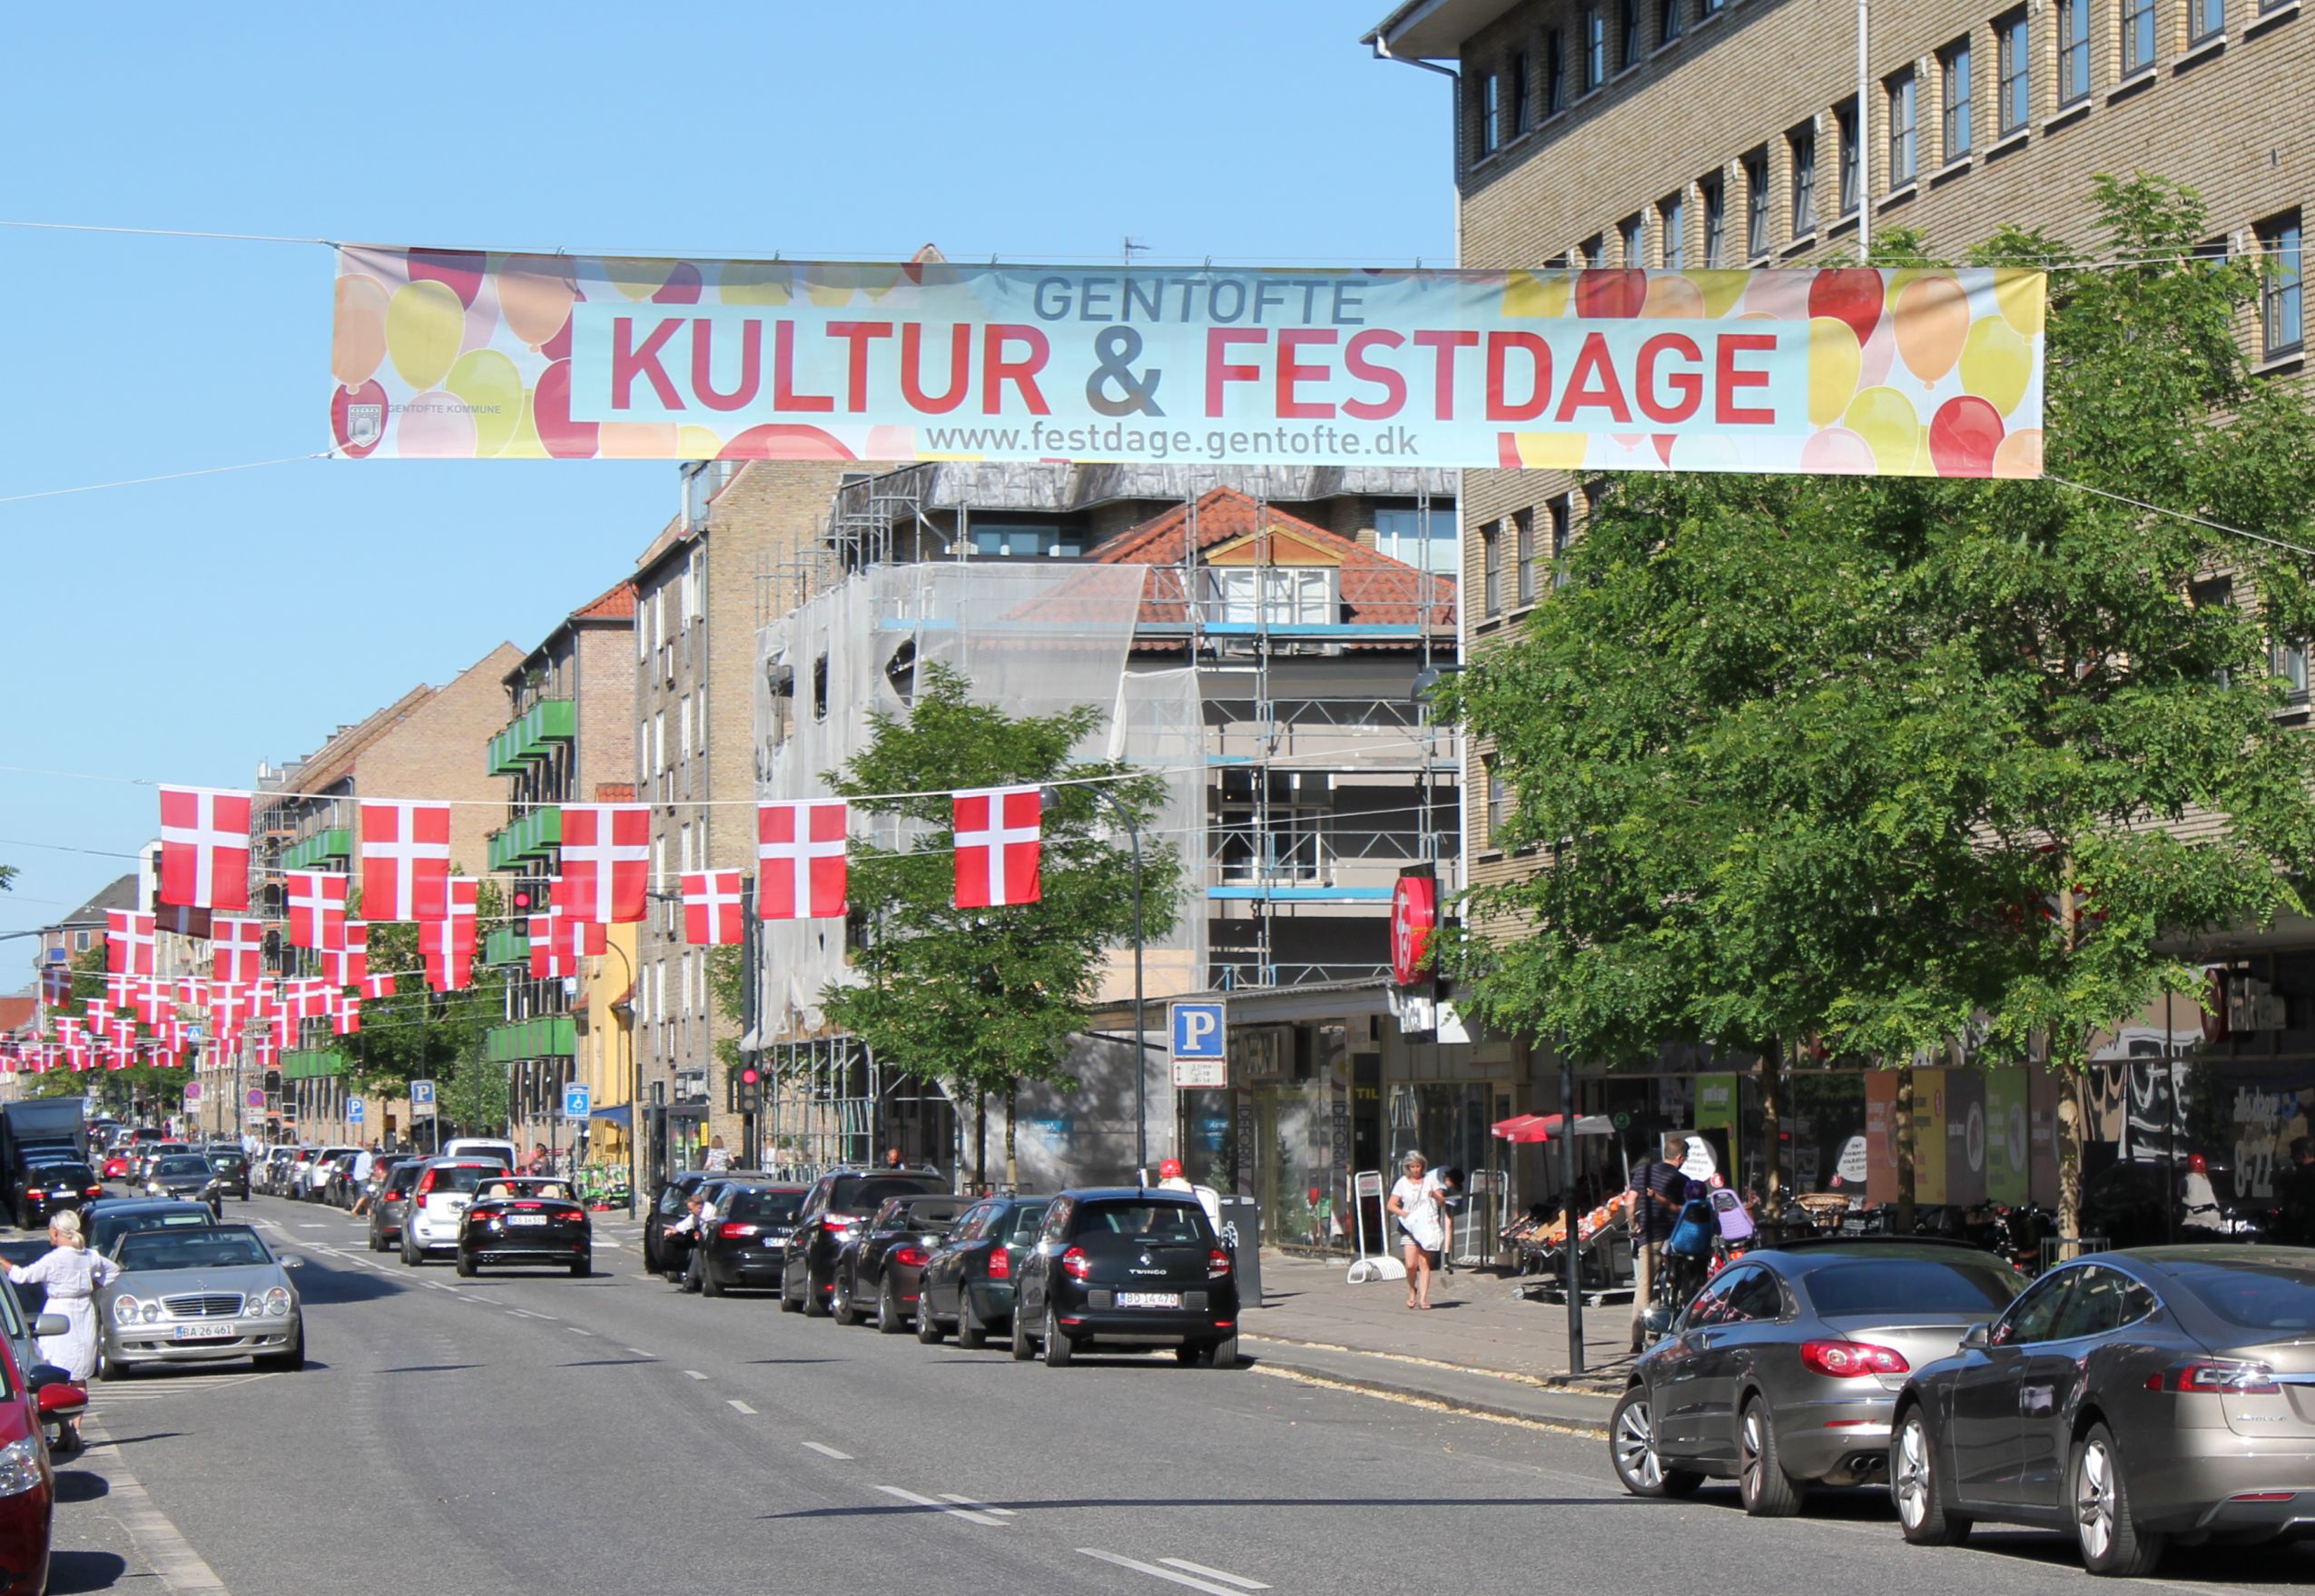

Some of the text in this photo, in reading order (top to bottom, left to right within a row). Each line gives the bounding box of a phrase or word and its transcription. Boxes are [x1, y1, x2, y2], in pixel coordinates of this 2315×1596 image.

[1033, 276, 1365, 325] GENTOFTE
[611, 316, 1777, 425] KULTUR & FESTDAGE
[389, 404, 501, 415] GENTOFTE KOMMUNE
[926, 421, 1419, 459] www.festdage.gentofte.dk
[1182, 1011, 1215, 1050] P
[350, 1100, 360, 1113] P
[416, 1085, 429, 1101] P
[1238, 1104, 1252, 1169] IDEFORM
[1333, 1100, 1346, 1170] IDEFORM
[2234, 1139, 2273, 1198] 8-22
[1144, 1293, 1156, 1304] 14
[1158, 1294, 1177, 1304] 470
[182, 1325, 232, 1337] BA 26 461
